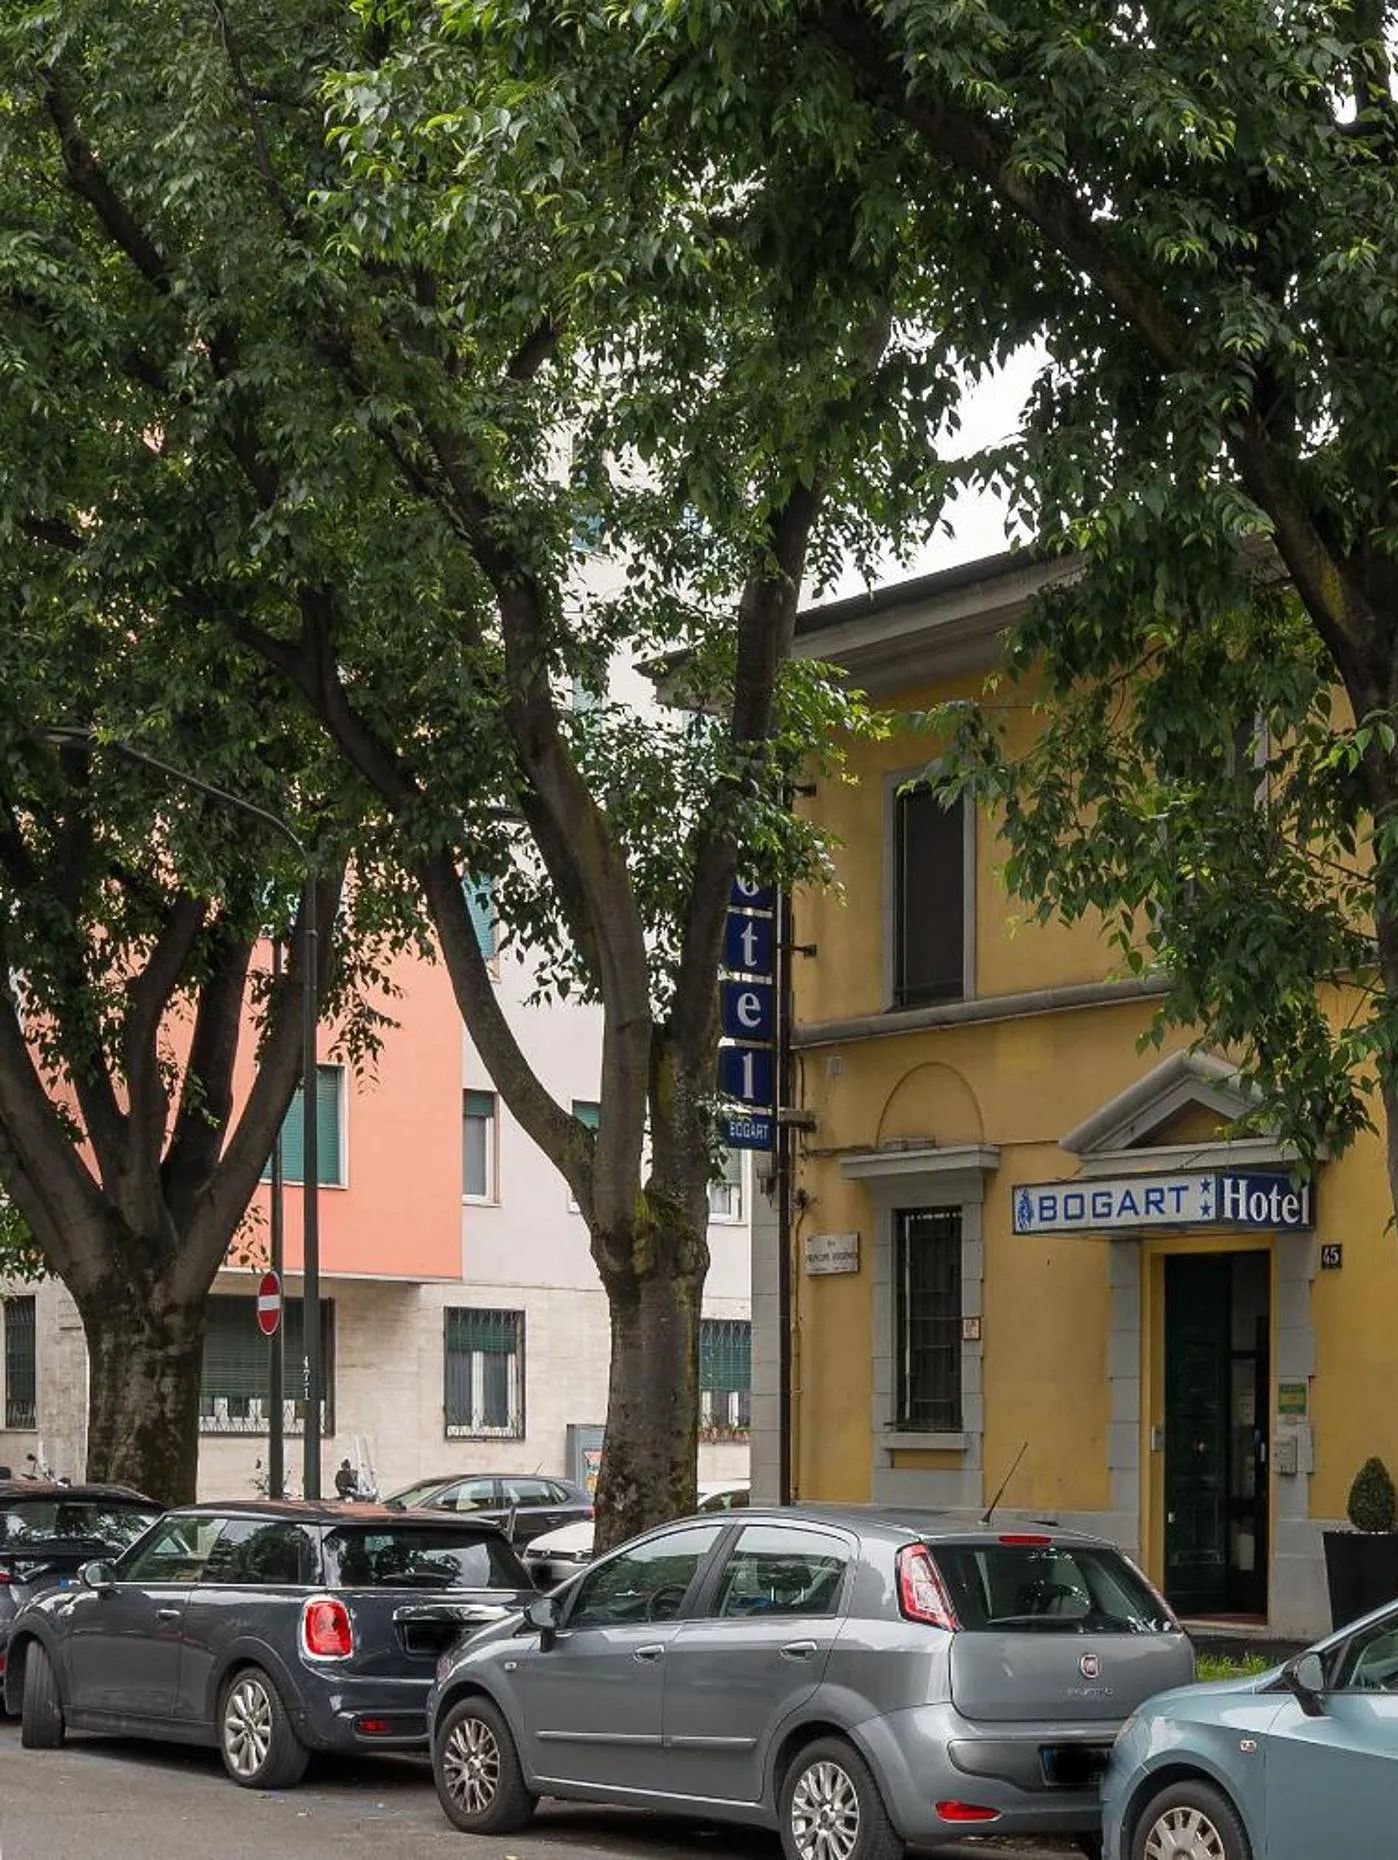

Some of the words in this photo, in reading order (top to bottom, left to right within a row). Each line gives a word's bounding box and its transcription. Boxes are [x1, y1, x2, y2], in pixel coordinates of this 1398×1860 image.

[736, 861, 763, 1099] otel
[1038, 1184, 1190, 1223] BOGART
[1223, 1177, 1310, 1225] Hotel
[1323, 1246, 1340, 1265] 45
